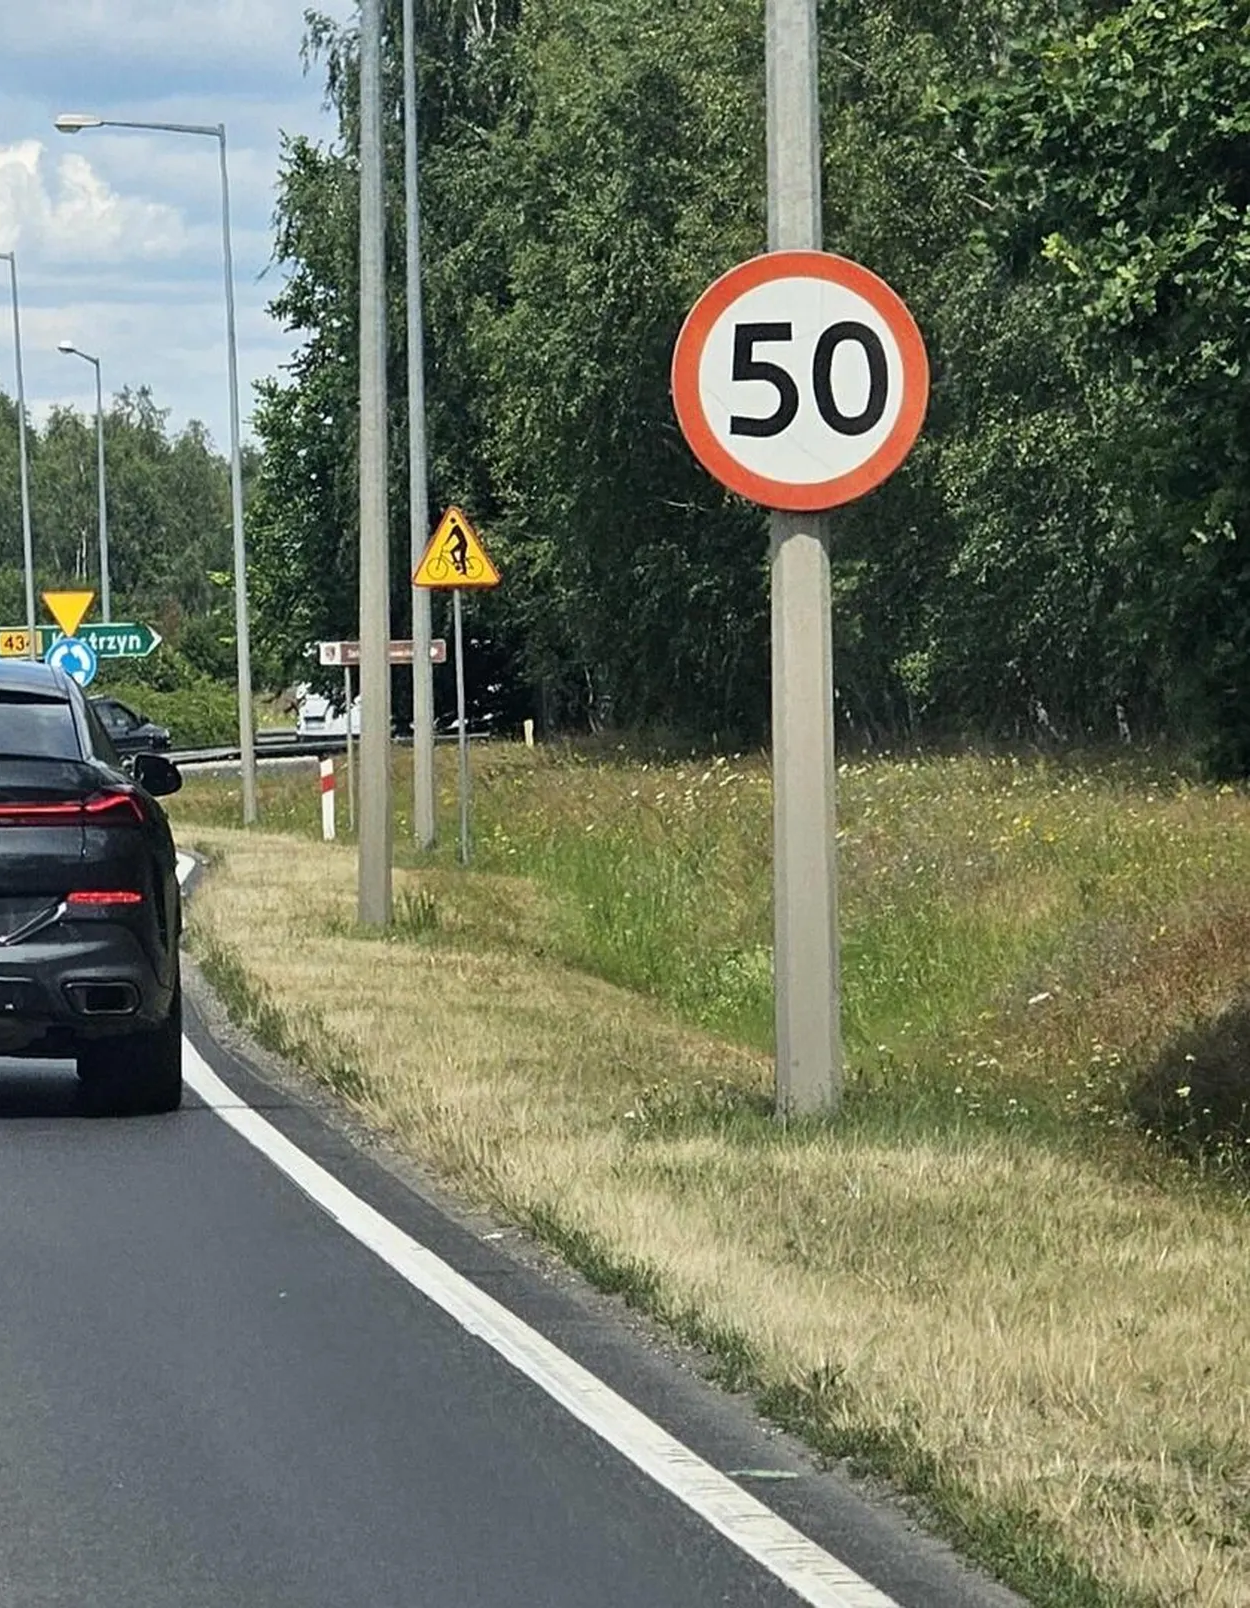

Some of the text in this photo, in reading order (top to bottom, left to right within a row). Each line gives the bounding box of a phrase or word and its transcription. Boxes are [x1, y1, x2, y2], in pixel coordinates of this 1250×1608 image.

[730, 320, 889, 438] 50
[4, 632, 141, 655] 43 Ktrzyn
